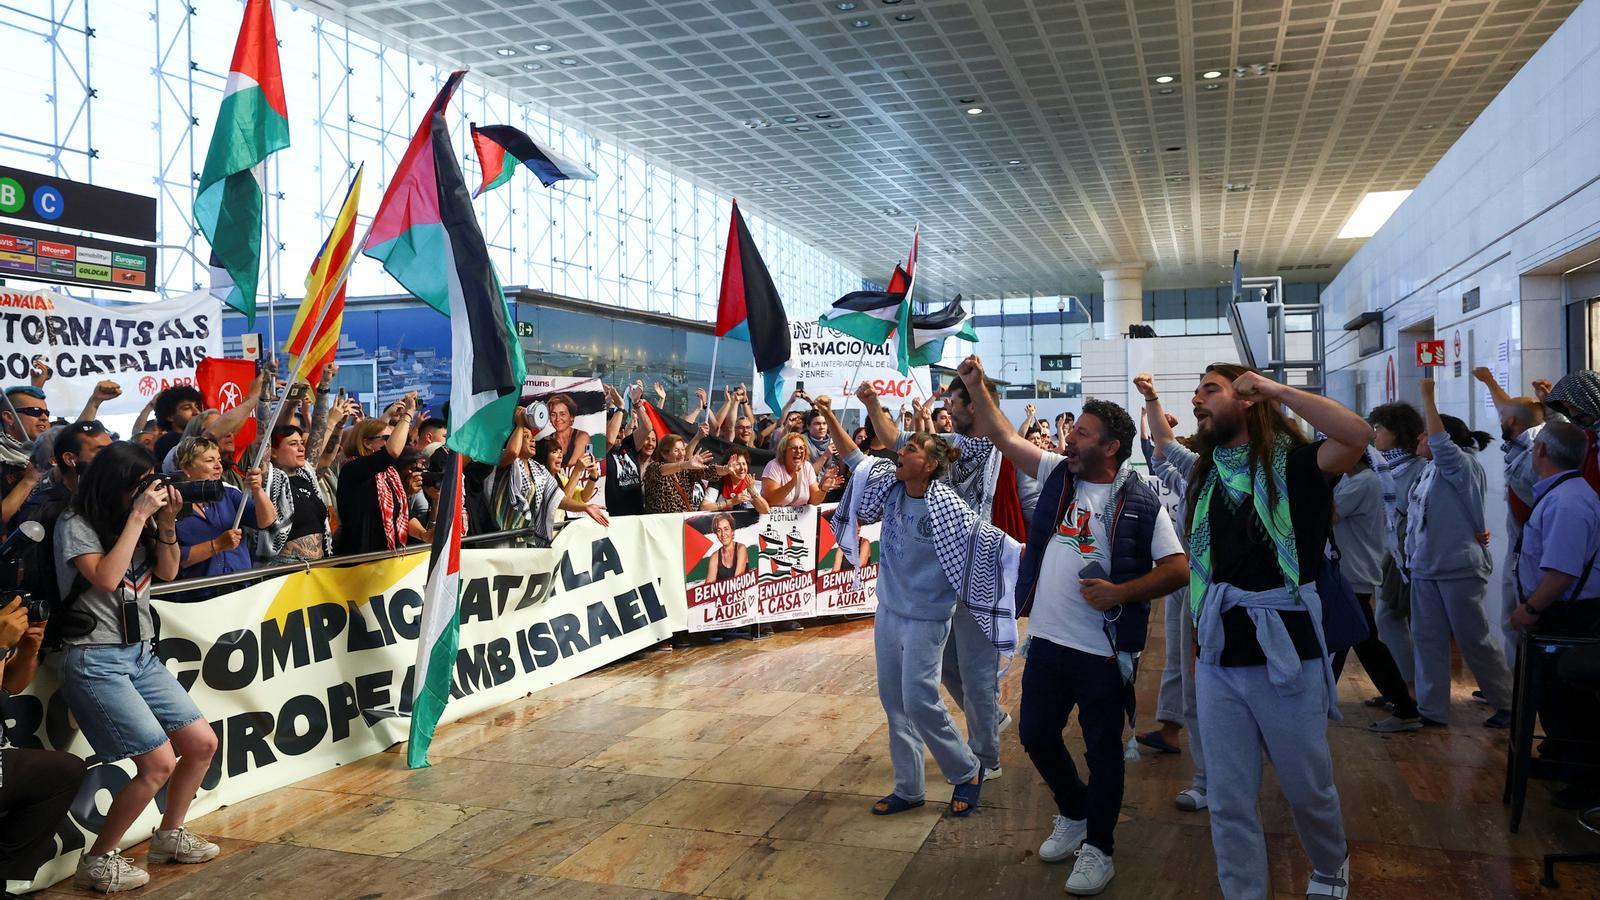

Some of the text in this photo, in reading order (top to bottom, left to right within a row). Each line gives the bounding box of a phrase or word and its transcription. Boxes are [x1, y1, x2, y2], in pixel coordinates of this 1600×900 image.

[1, 183, 16, 206] B
[41, 193, 57, 213] C
[114, 255, 143, 265] Europcar
[78, 267, 109, 277] GOLDCAR
[0, 312, 210, 347] TORNATS ALS
[799, 341, 890, 356] RNACIONAL
[770, 514, 798, 522] FLOTILLA
[560, 536, 624, 592] LA
[695, 571, 756, 603] BENVINGUDA
[759, 573, 813, 600] ENVINGUDA
[838, 586, 845, 594] A
[715, 598, 723, 608] A
[768, 592, 801, 614] CASA
[828, 592, 866, 608] LAURA
[704, 600, 748, 622] LAURA
[450, 637, 517, 700] MB
[516, 577, 668, 674] ISRAEL
